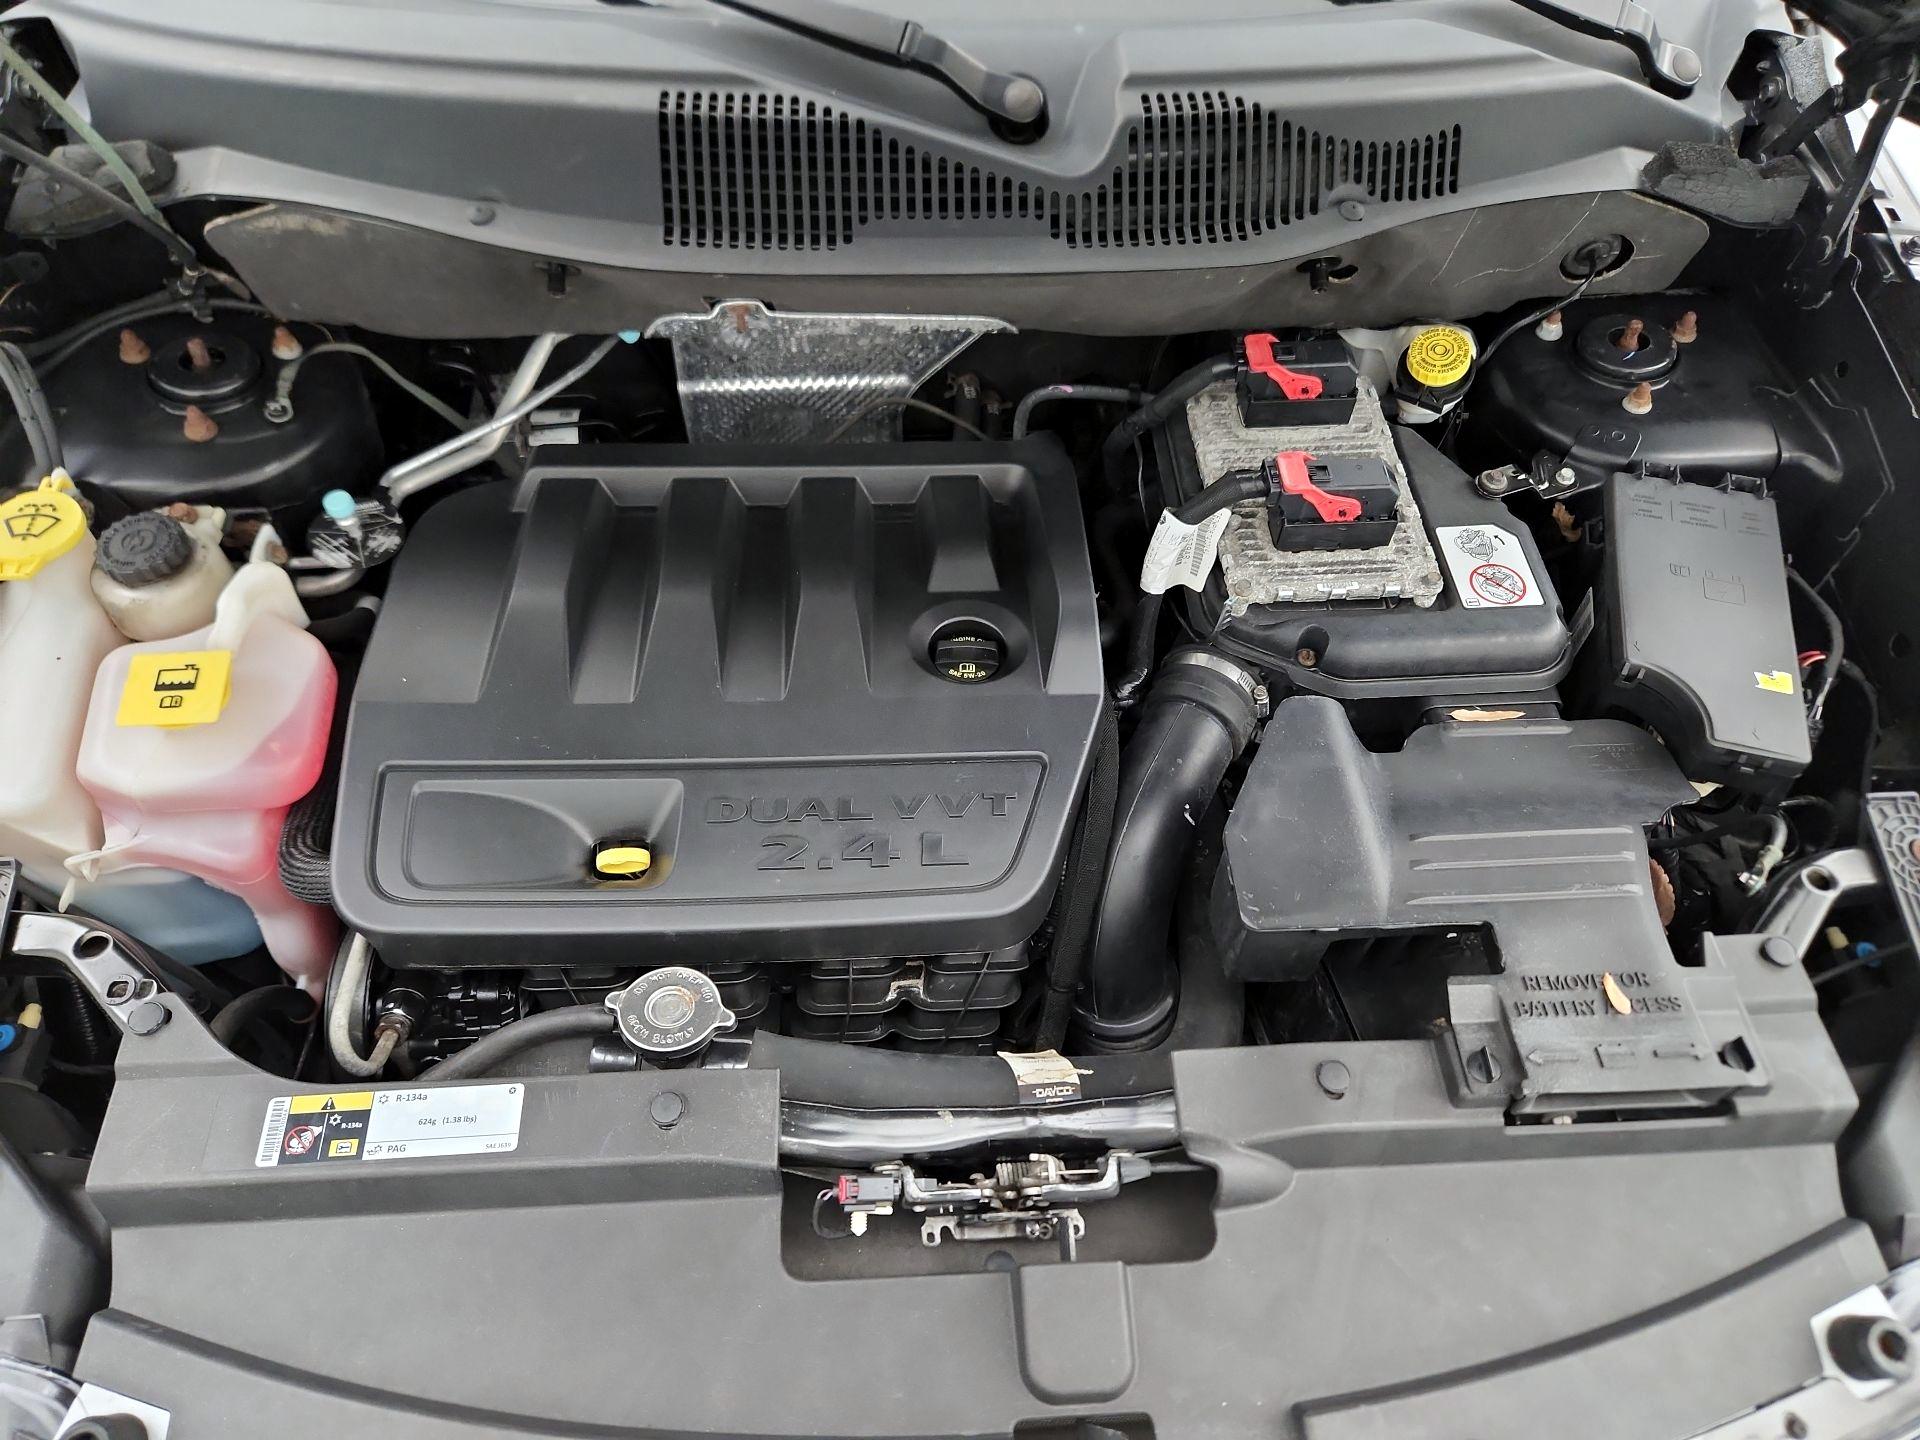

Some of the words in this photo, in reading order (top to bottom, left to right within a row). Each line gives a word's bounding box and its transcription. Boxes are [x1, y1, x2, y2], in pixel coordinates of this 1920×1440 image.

[948, 668, 962, 678] SAE
[706, 796, 874, 824] DUAL
[890, 792, 1017, 819] VVT
[633, 982, 648, 996] DO
[649, 971, 672, 982] NOT
[676, 971, 704, 985] OPEN
[1608, 971, 1650, 988] OR
[1513, 1000, 1596, 1017] BATTERY
[1605, 996, 1682, 1015] CESS
[395, 1093, 428, 1103] R-134a
[1035, 1085, 1074, 1098] DAYCO
[418, 1117, 437, 1126] 624g
[387, 1143, 407, 1154] PAG
